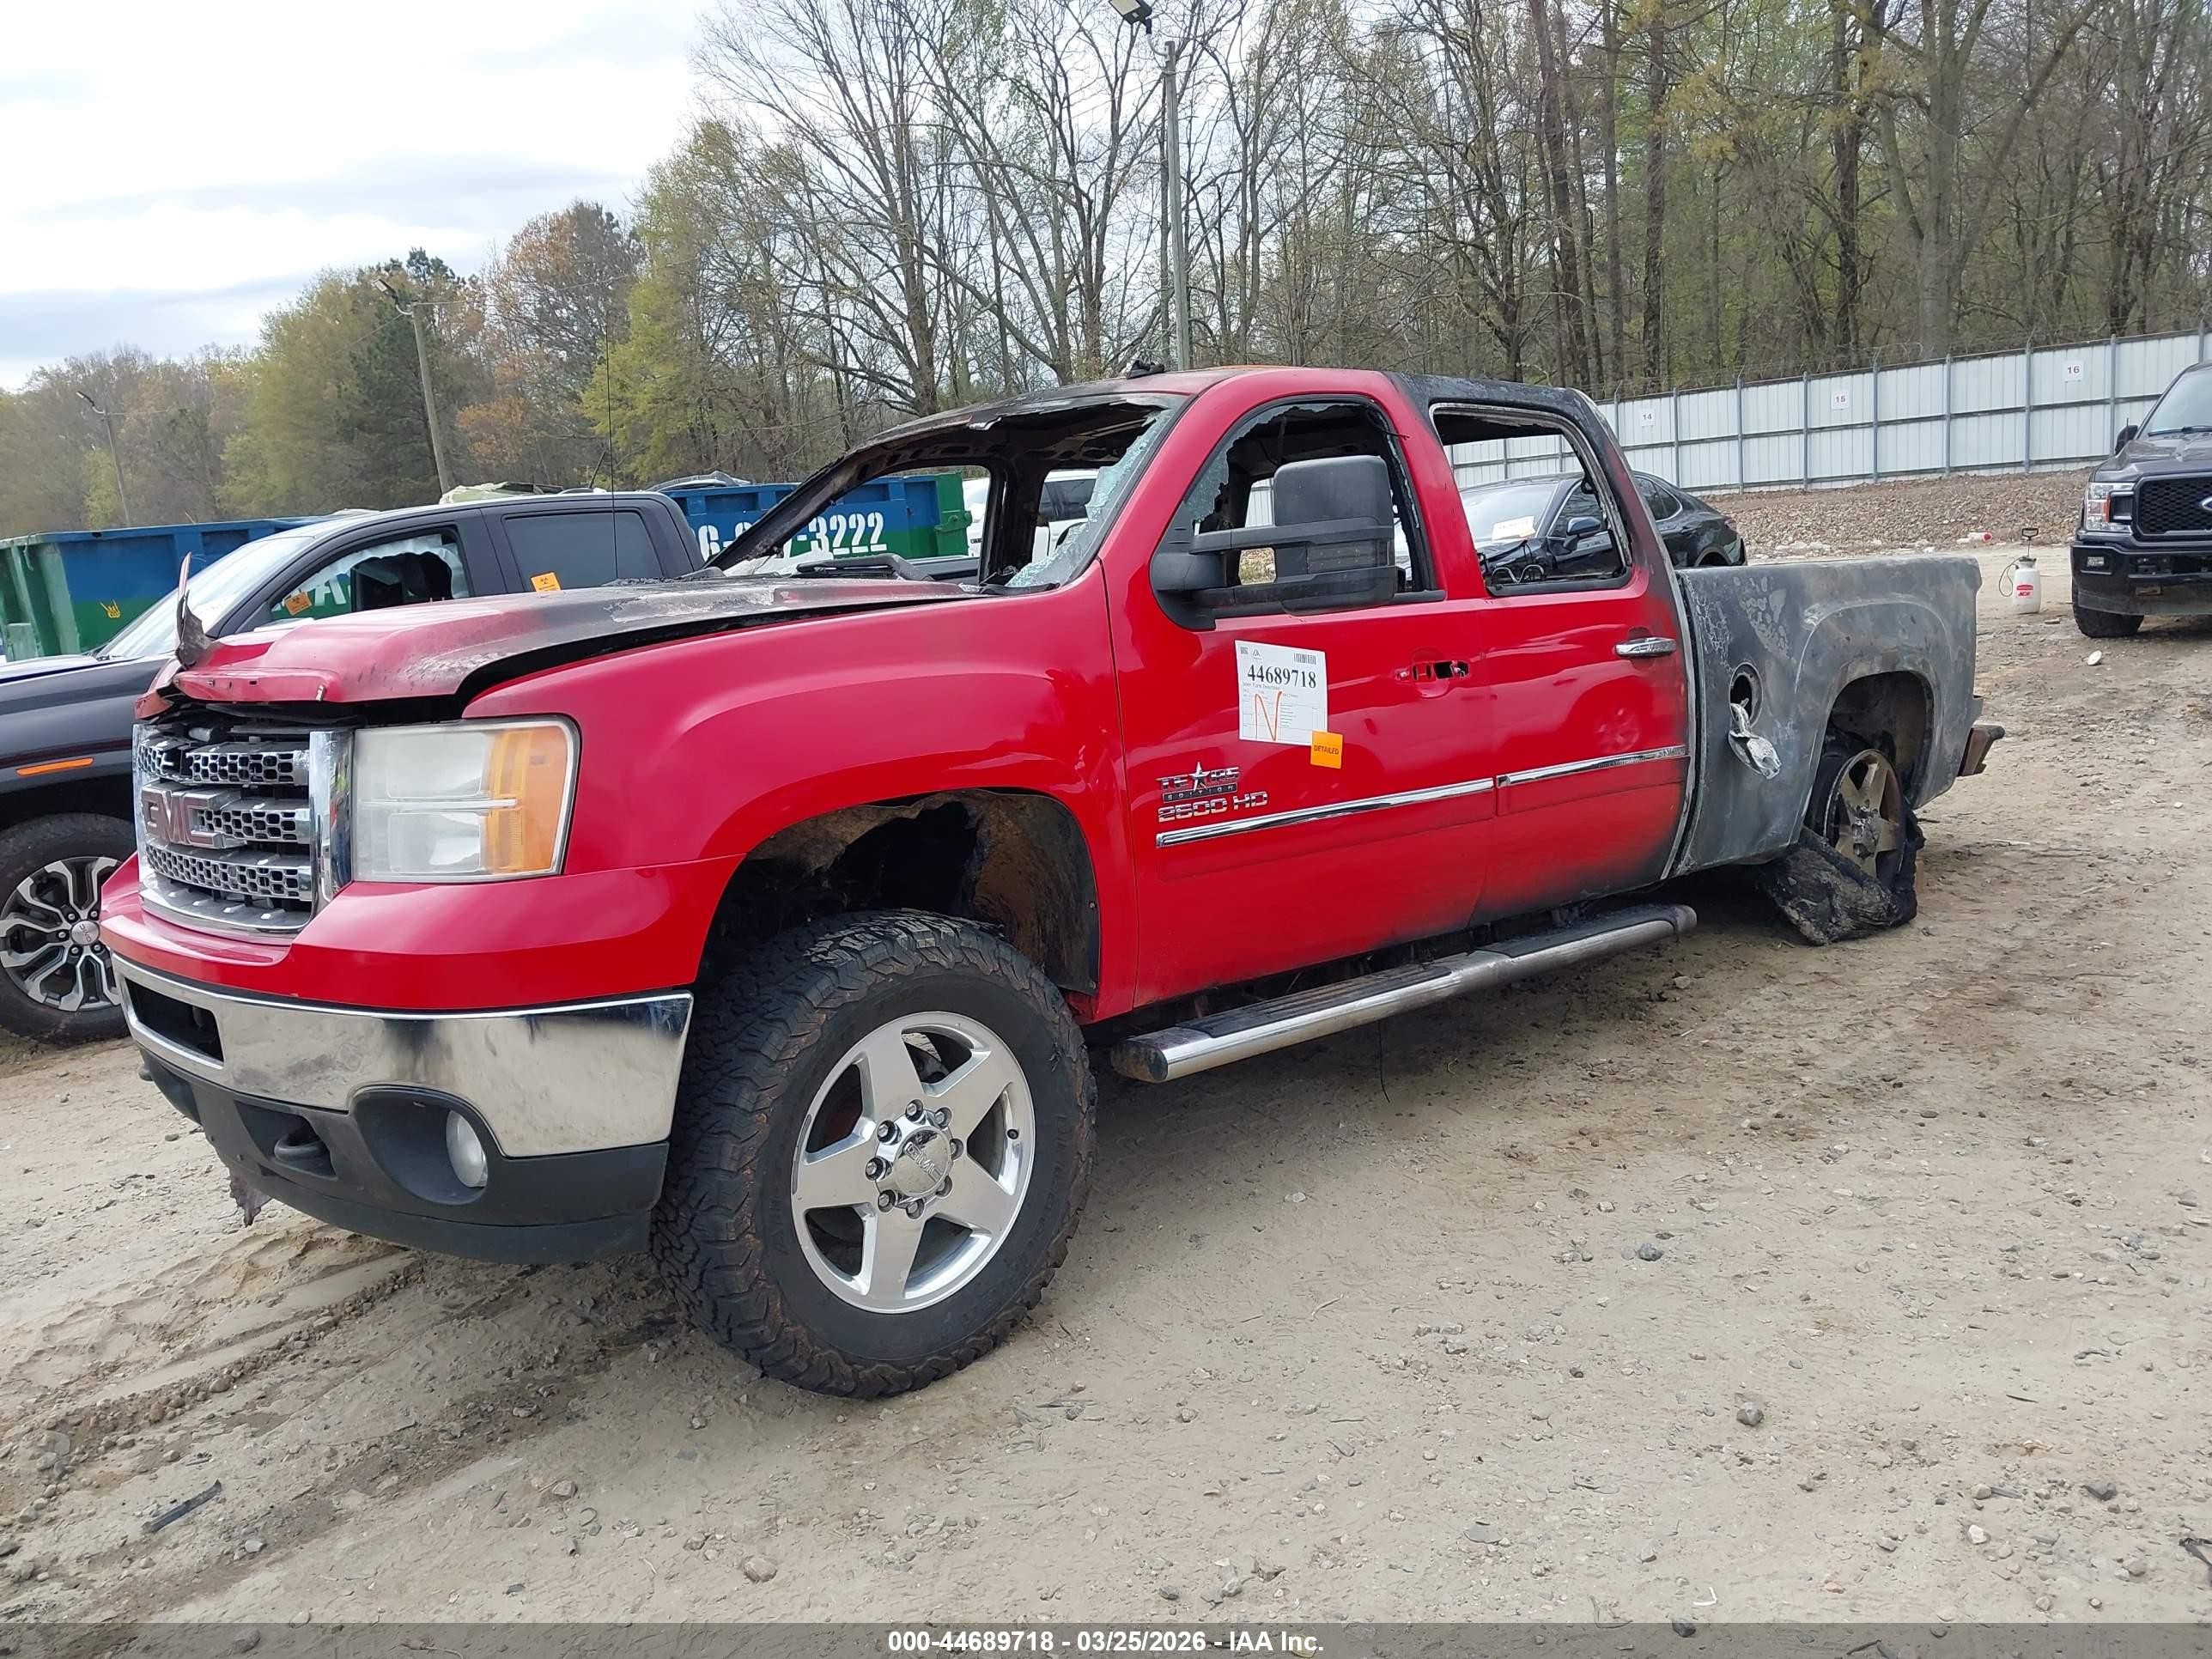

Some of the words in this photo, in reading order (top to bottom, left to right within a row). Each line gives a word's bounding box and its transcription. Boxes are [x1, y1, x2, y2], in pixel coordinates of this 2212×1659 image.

[2067, 365, 2080, 374] 16
[1247, 664, 1316, 689] 44689718
[1255, 690, 1283, 741] N
[1314, 744, 1340, 755] DETAILED
[141, 788, 220, 849] GMC
[1158, 797, 1228, 823] 2500
[1232, 790, 1268, 811] HD
[903, 1141, 943, 1183] GMC
